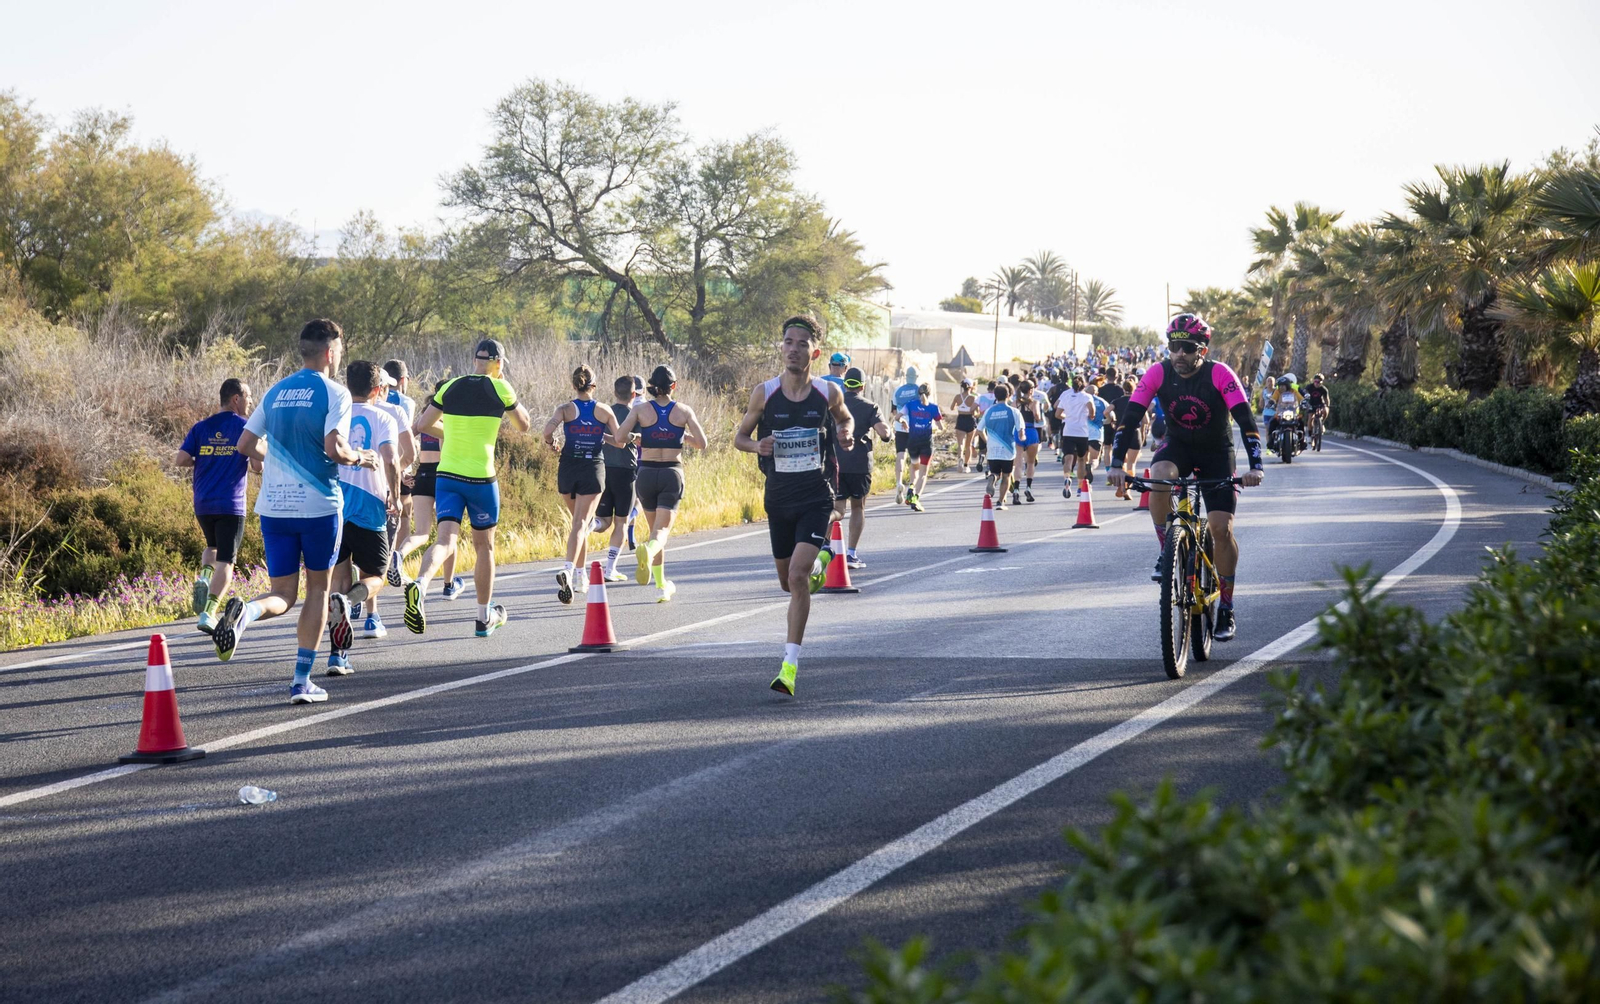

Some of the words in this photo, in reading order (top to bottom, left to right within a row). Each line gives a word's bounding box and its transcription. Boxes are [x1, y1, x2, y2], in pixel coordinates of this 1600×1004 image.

[275, 387, 315, 401] ALMERÍA
[569, 425, 602, 434] GALO
[776, 438, 817, 449] YOUNESS
